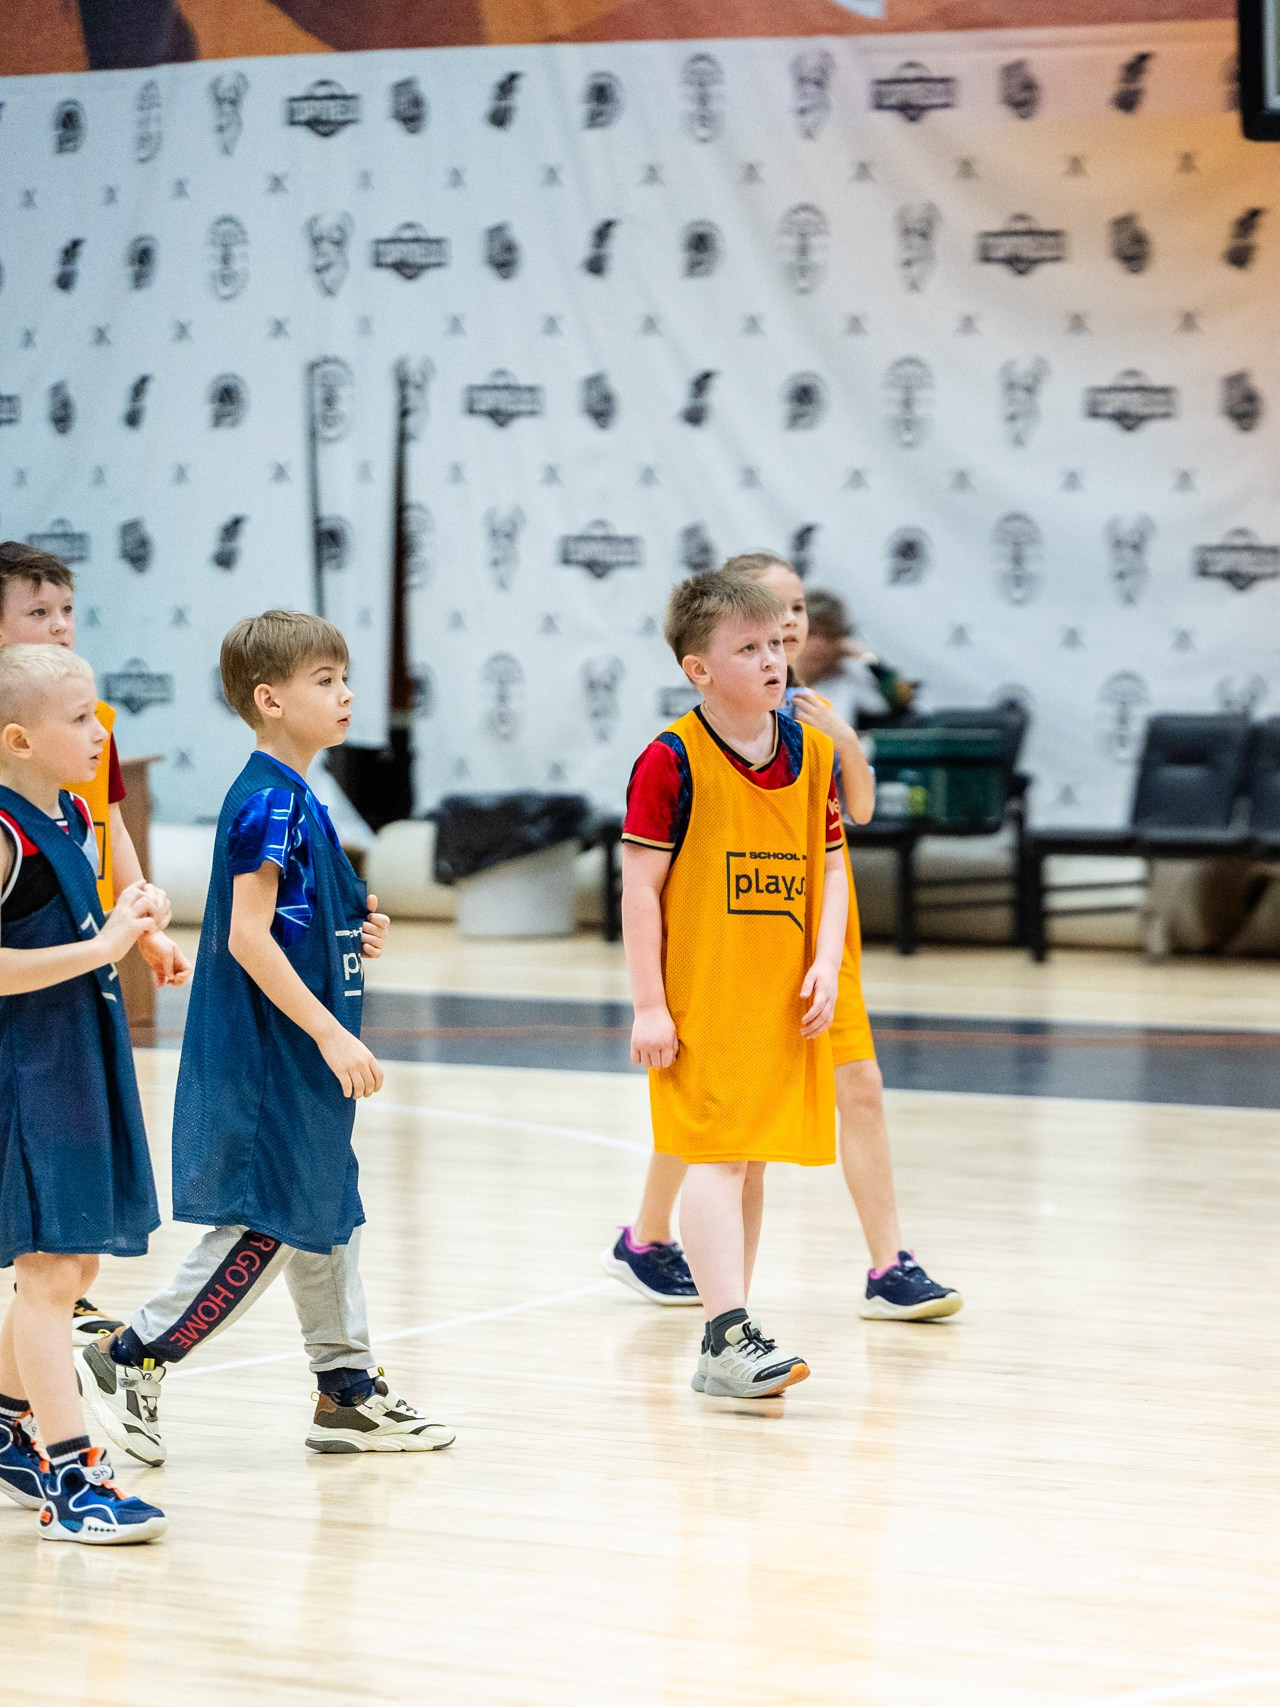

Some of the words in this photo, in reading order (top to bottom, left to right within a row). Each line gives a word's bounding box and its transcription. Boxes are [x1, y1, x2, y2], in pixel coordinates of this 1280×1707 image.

[749, 851, 801, 861] SCHOOL
[225, 1250, 261, 1287] GO
[169, 1283, 235, 1349] HOME
